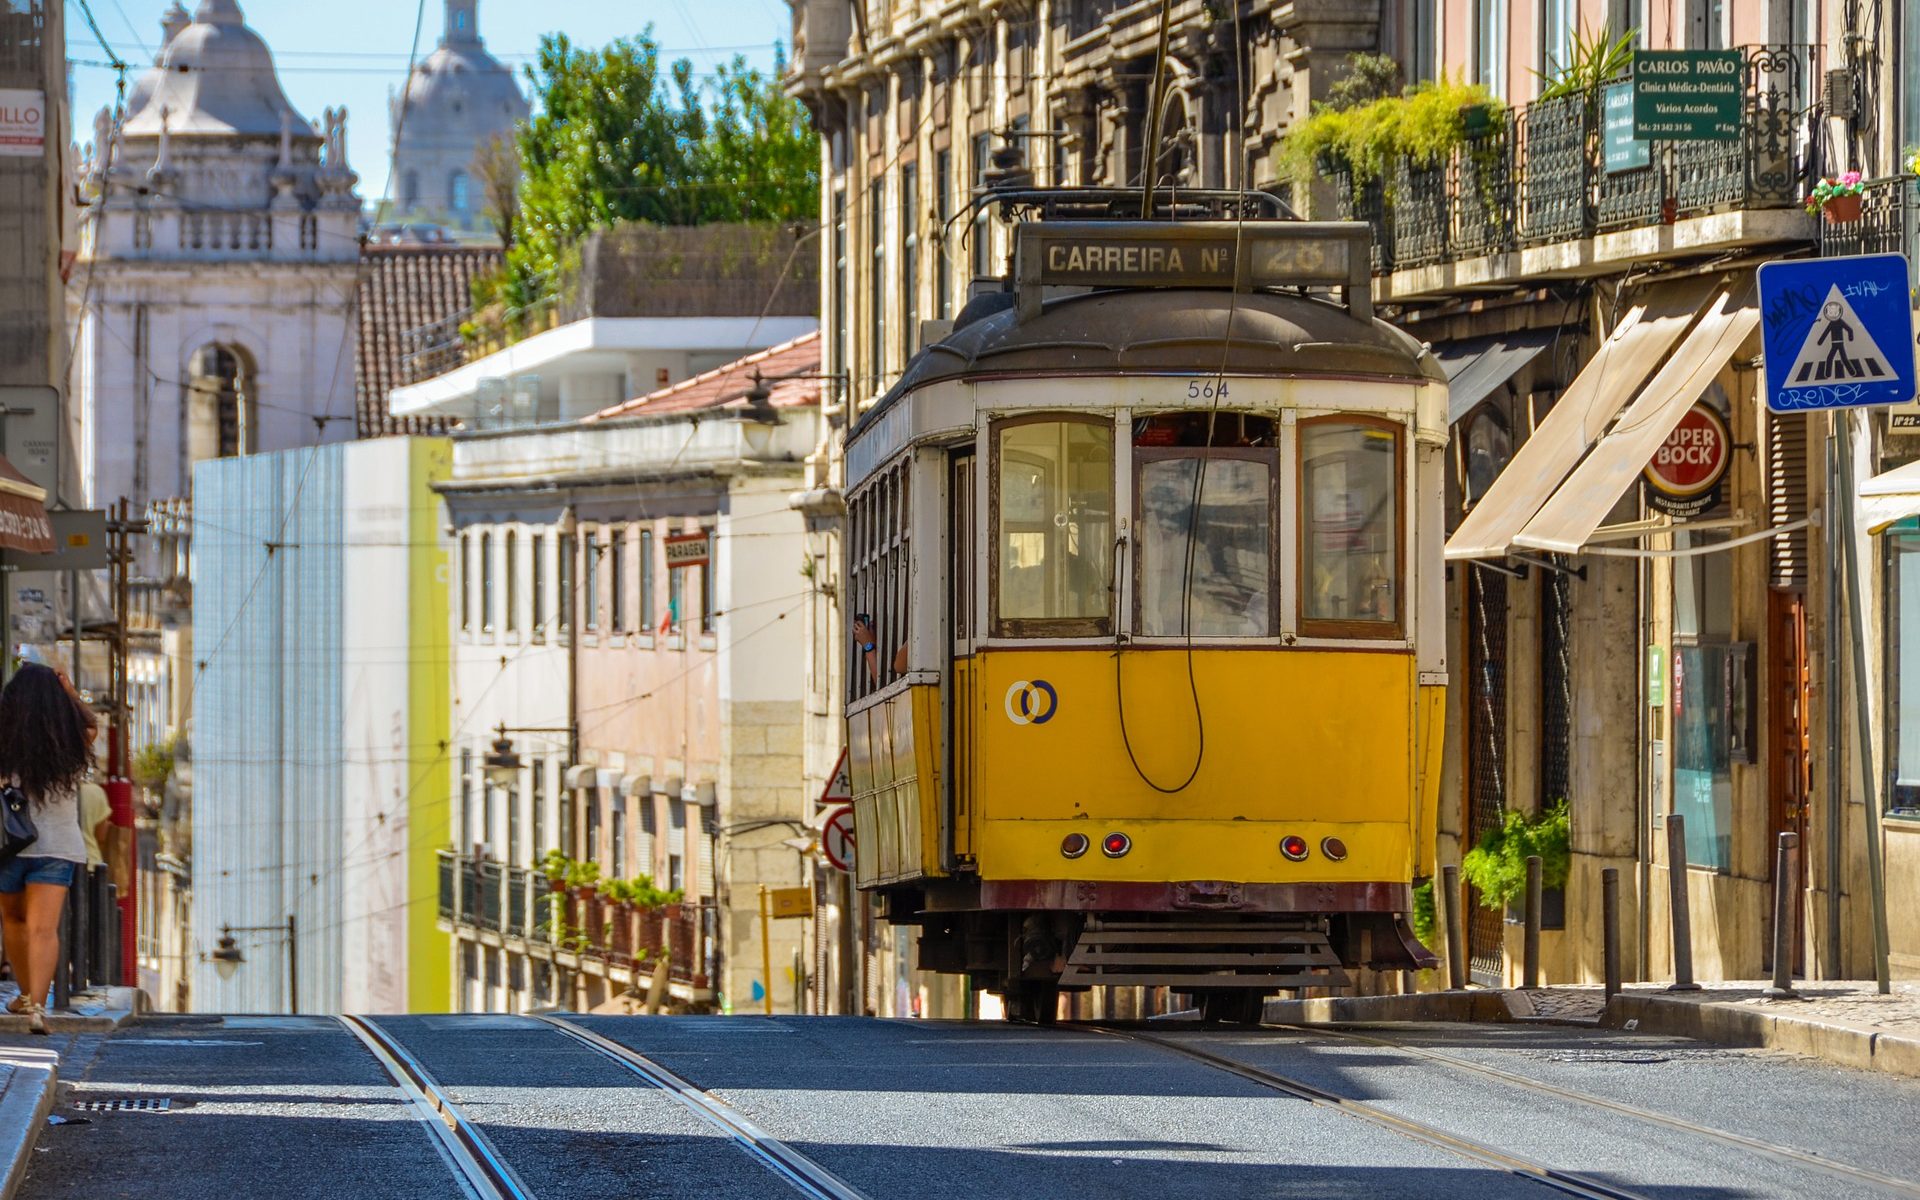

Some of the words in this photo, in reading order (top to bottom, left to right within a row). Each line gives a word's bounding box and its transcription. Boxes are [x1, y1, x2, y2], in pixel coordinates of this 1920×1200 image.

[1638, 60, 1690, 74] CARLOS
[1696, 58, 1736, 74] PAVÃO
[1668, 81, 1735, 93] Médica-Dentária
[1656, 103, 1682, 114] Vários
[1684, 103, 1719, 114] Acordos
[1652, 123, 1660, 132] 21
[1049, 246, 1184, 273] CARREIRA
[1187, 380, 1230, 399] 564
[1666, 427, 1716, 447] UPER
[1657, 446, 1713, 465] BOCK
